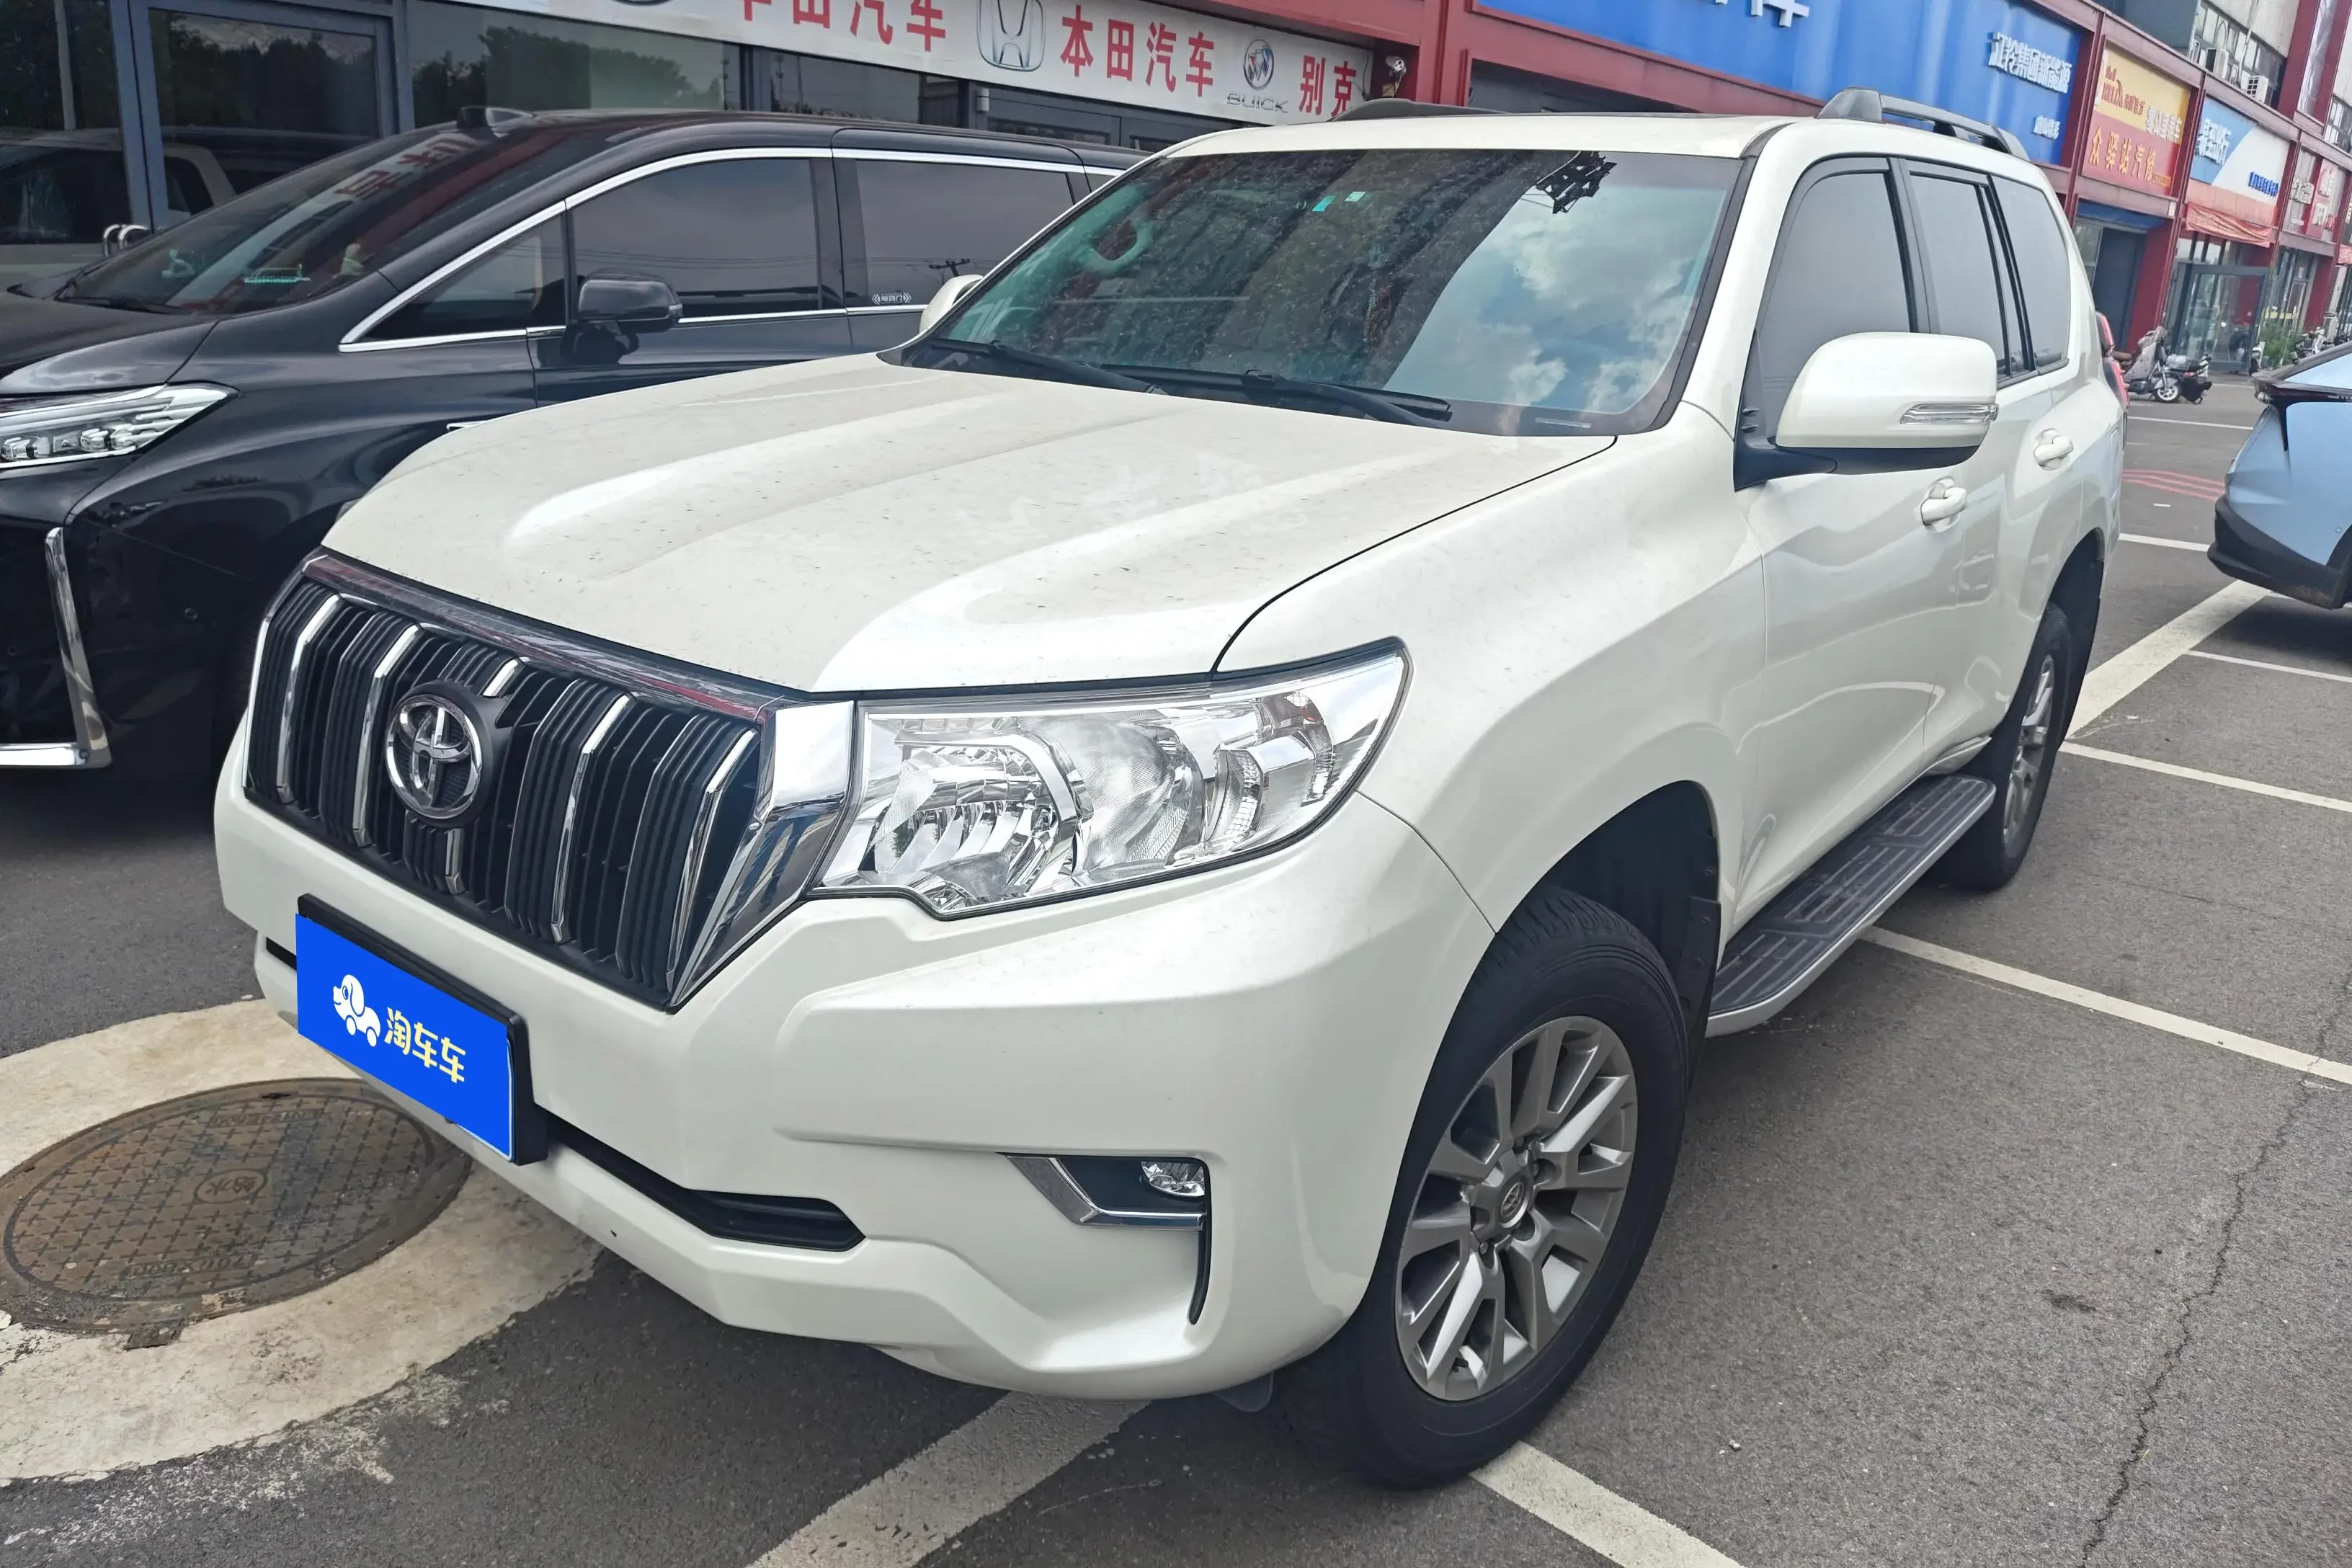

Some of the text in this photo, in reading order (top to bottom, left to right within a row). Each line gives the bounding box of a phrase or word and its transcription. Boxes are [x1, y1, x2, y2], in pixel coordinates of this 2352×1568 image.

[738, 0, 945, 52] 汽车
[1060, 5, 1215, 98] 本田汽车
[1225, 92, 1289, 114] BUICK
[1298, 55, 1357, 117] 别克
